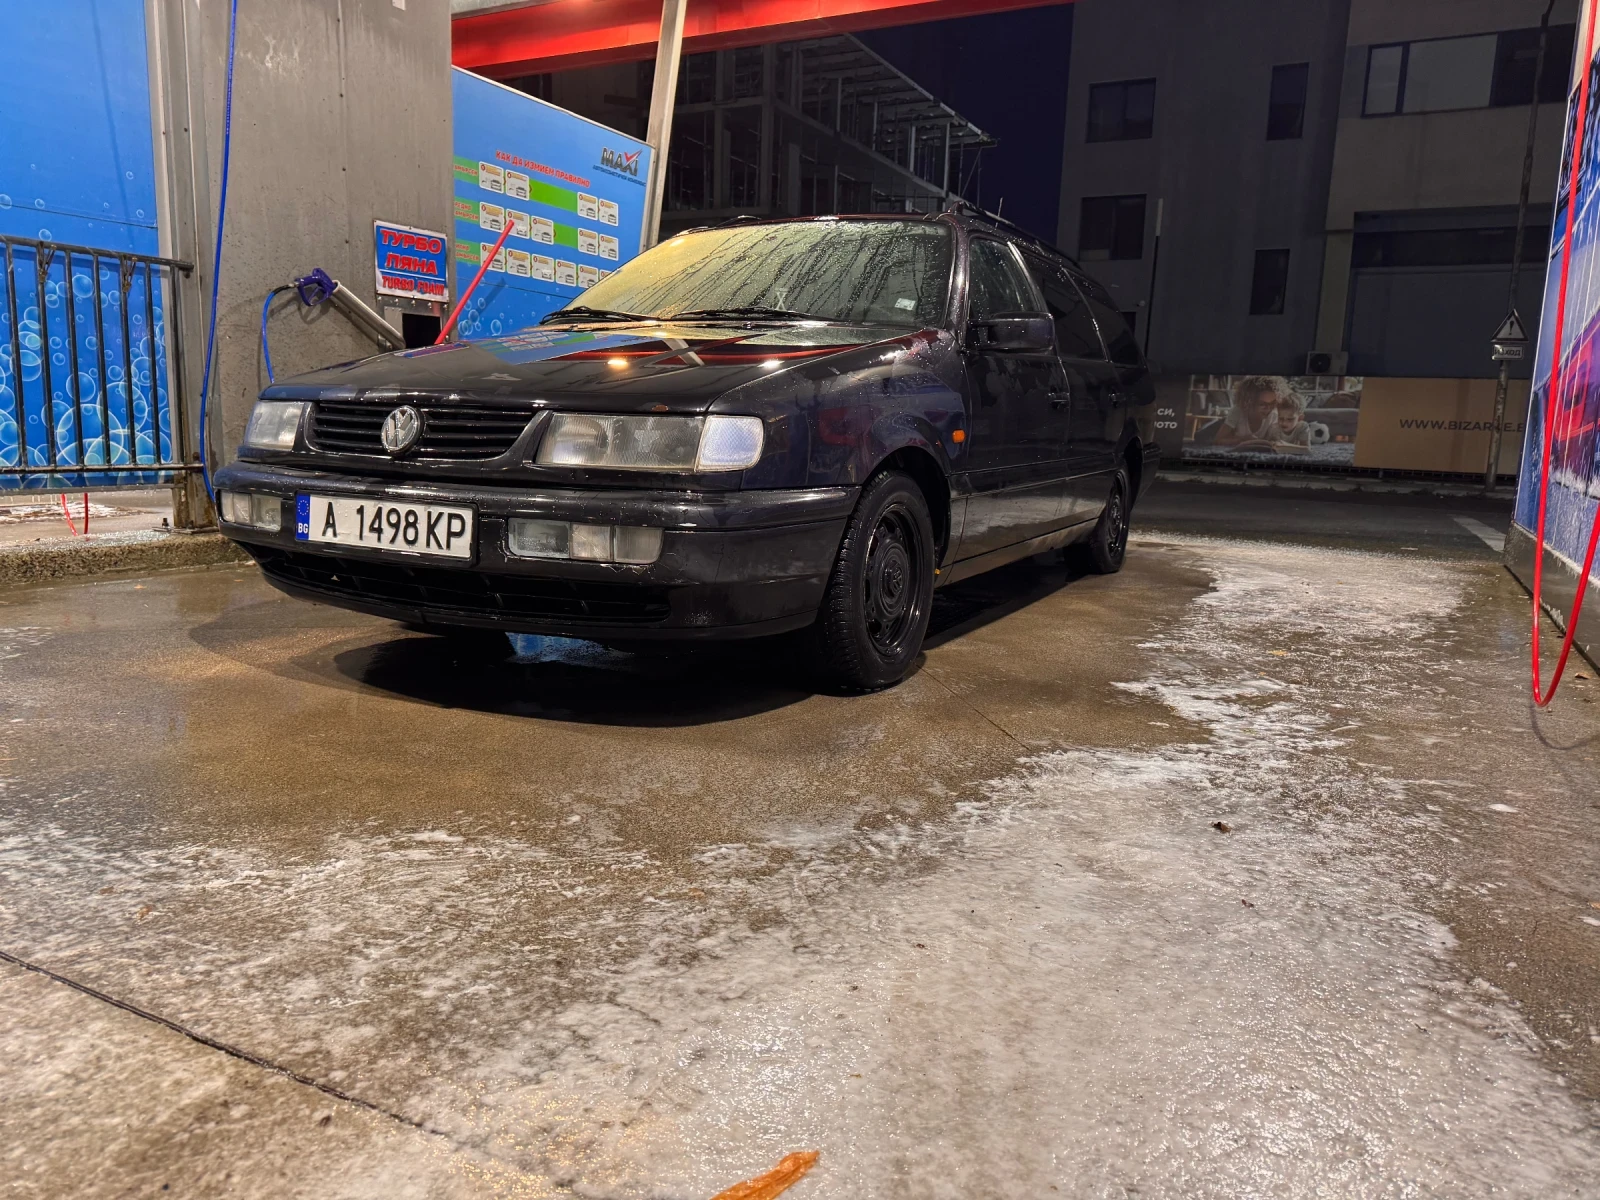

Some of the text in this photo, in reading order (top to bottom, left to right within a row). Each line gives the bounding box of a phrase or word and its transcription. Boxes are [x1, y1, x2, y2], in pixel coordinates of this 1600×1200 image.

[495, 150, 591, 189] КАК ДА ИЗМИЕМ ПРАВИЛНО
[600, 146, 643, 177] MAXI
[380, 229, 442, 254] ТУРБО
[385, 252, 438, 276] ПЯНА
[381, 275, 445, 297] TURBO FOAM
[1399, 418, 1525, 433] WWW.BIZARE.E
[298, 522, 309, 534] BG
[321, 501, 337, 538] A
